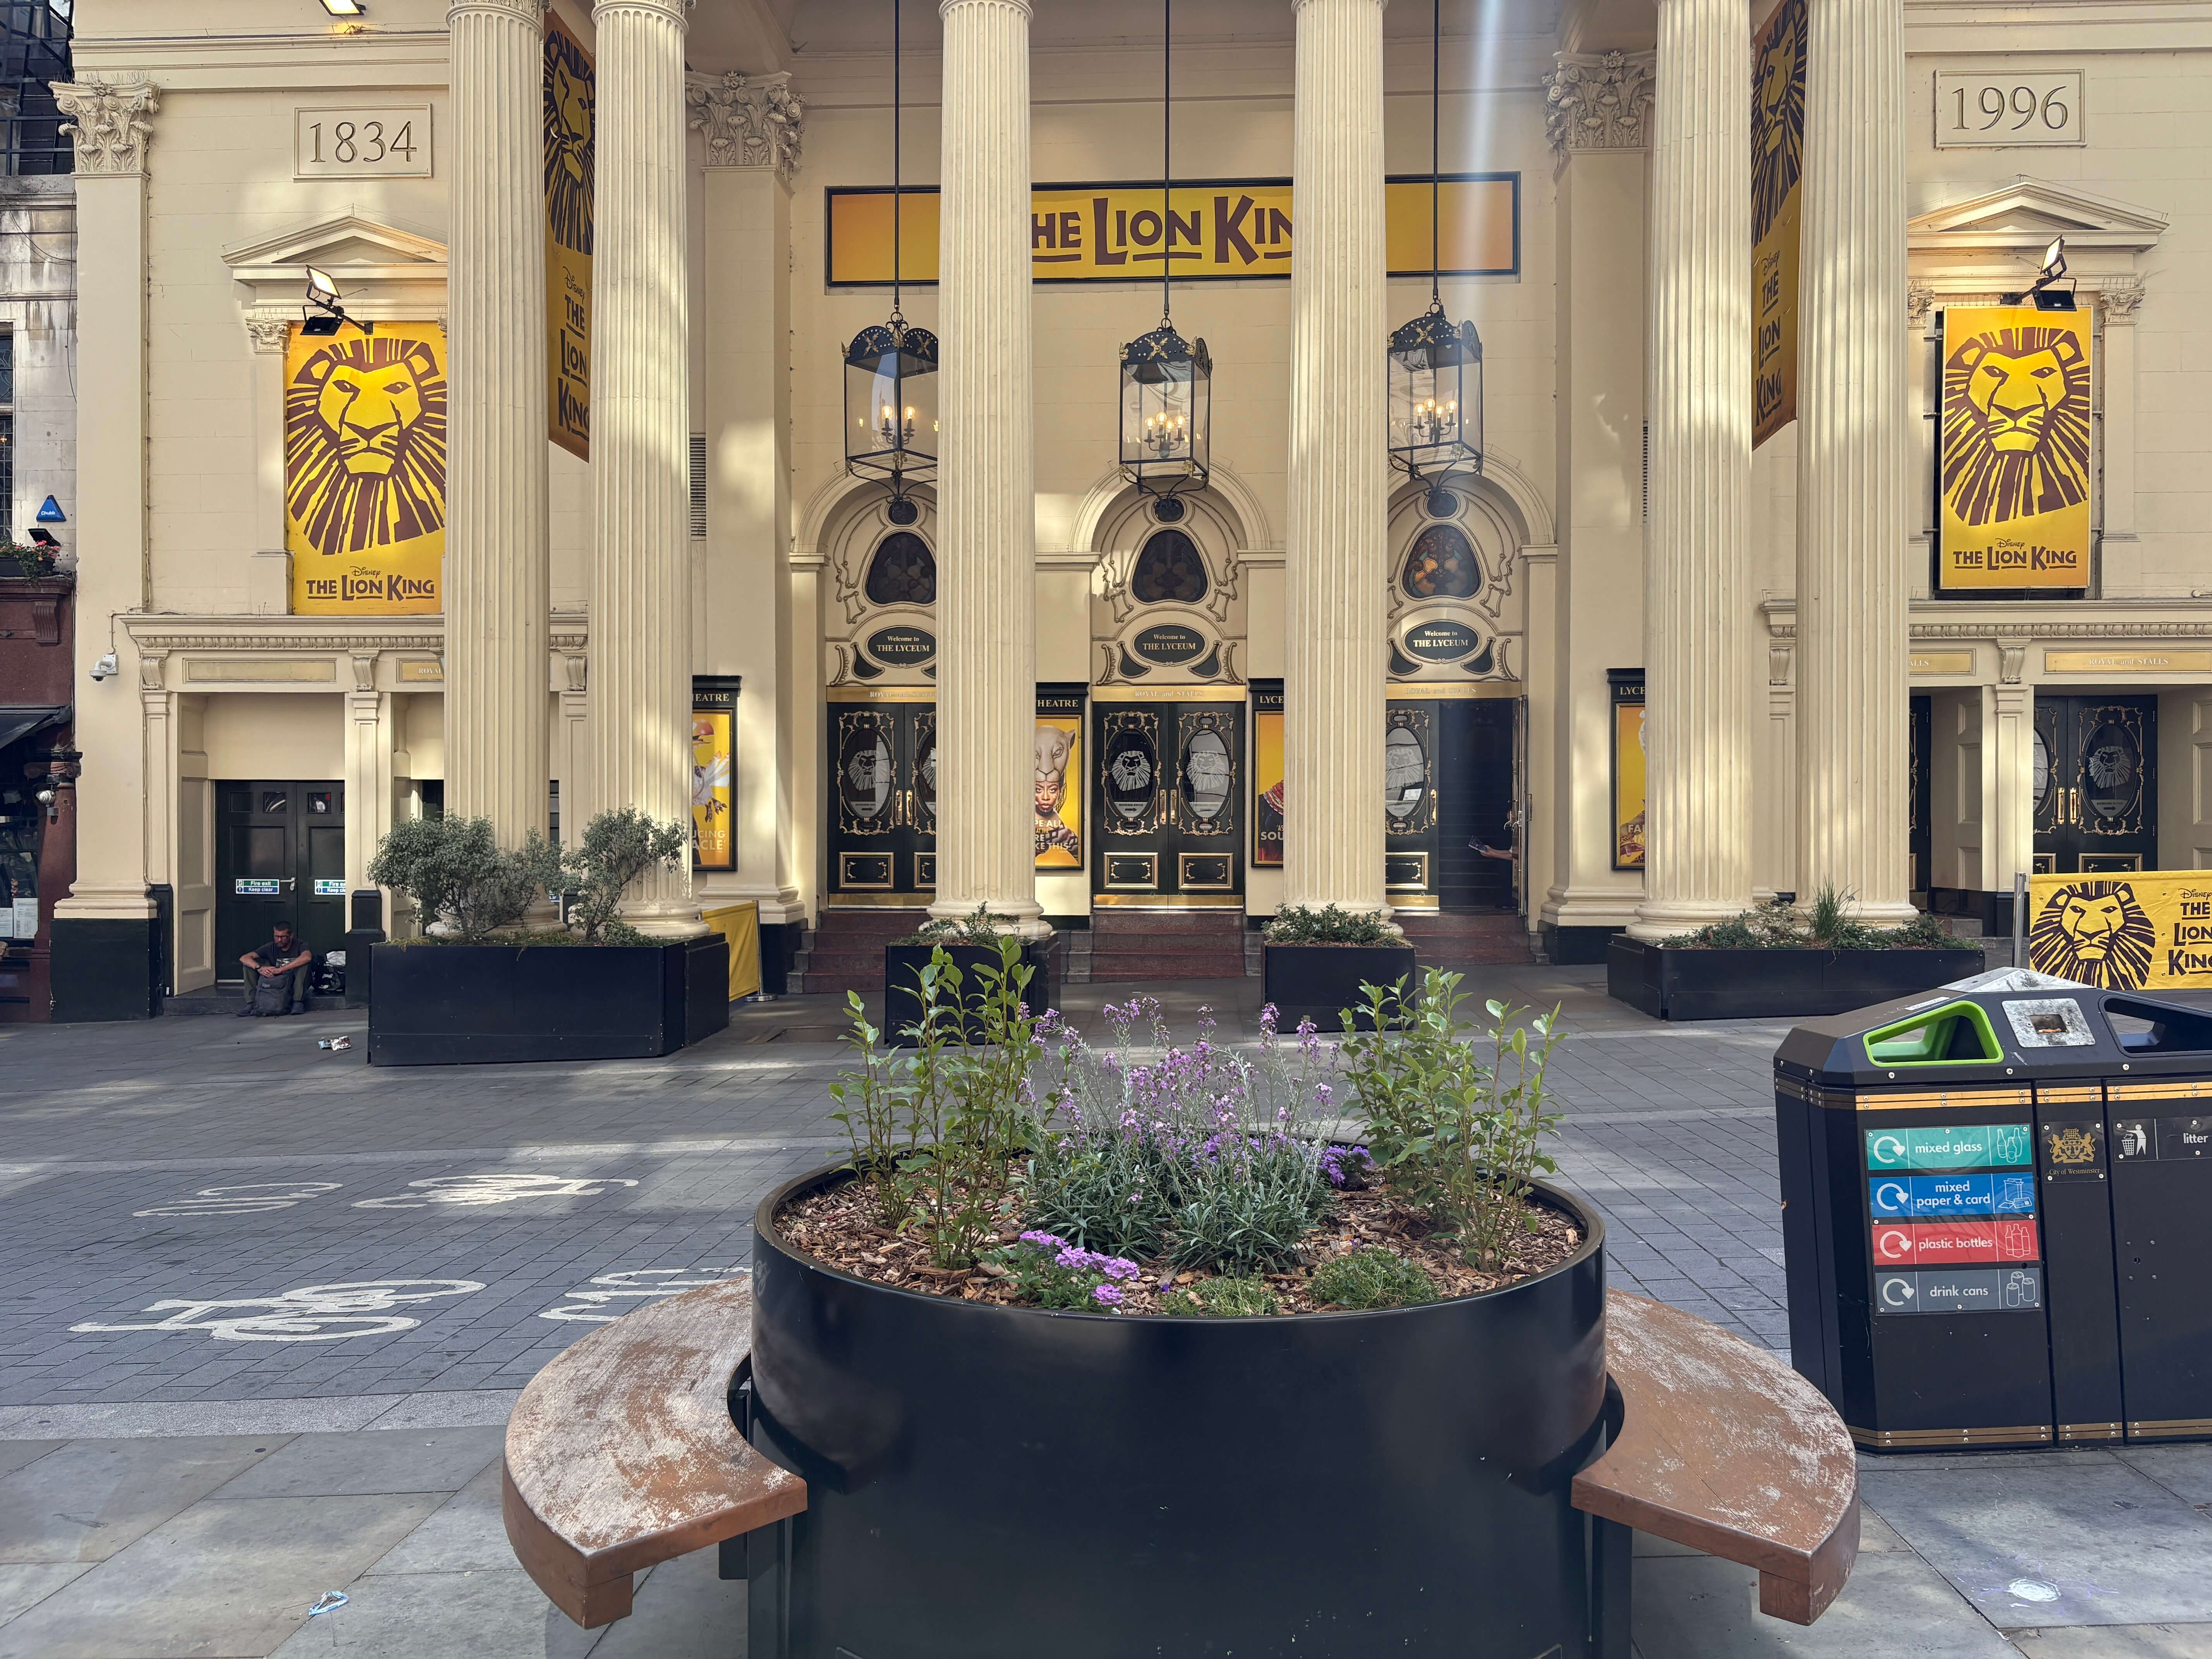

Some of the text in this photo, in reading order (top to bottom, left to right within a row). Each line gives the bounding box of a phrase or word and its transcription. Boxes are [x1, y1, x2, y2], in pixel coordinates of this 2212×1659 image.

[1953, 86, 2068, 130] 1996
[310, 121, 417, 163] 1834
[1032, 195, 1292, 265] HE LION KIN
[1762, 270, 1779, 309] THE
[565, 294, 585, 332] THE
[560, 328, 587, 378] LION
[1759, 316, 1781, 371] LION
[1756, 367, 1782, 426] KING
[1953, 546, 2076, 571] THE LION KING
[306, 575, 434, 601] THE LION KING
[692, 693, 730, 701] EATRE
[1260, 696, 1284, 704] LYCE
[1620, 687, 1645, 695] LYCE
[1261, 831, 1283, 840] SOU
[2180, 902, 2210, 915] THE
[2174, 922, 2212, 946] LION
[1915, 1141, 1983, 1155] mixed glass
[2183, 1132, 2209, 1144] litter
[1935, 1181, 1971, 1193] mixed
[1916, 1193, 1990, 1209] paper & card
[1918, 1236, 1993, 1251] plastic bottles
[1929, 1285, 1989, 1297] drink cans
